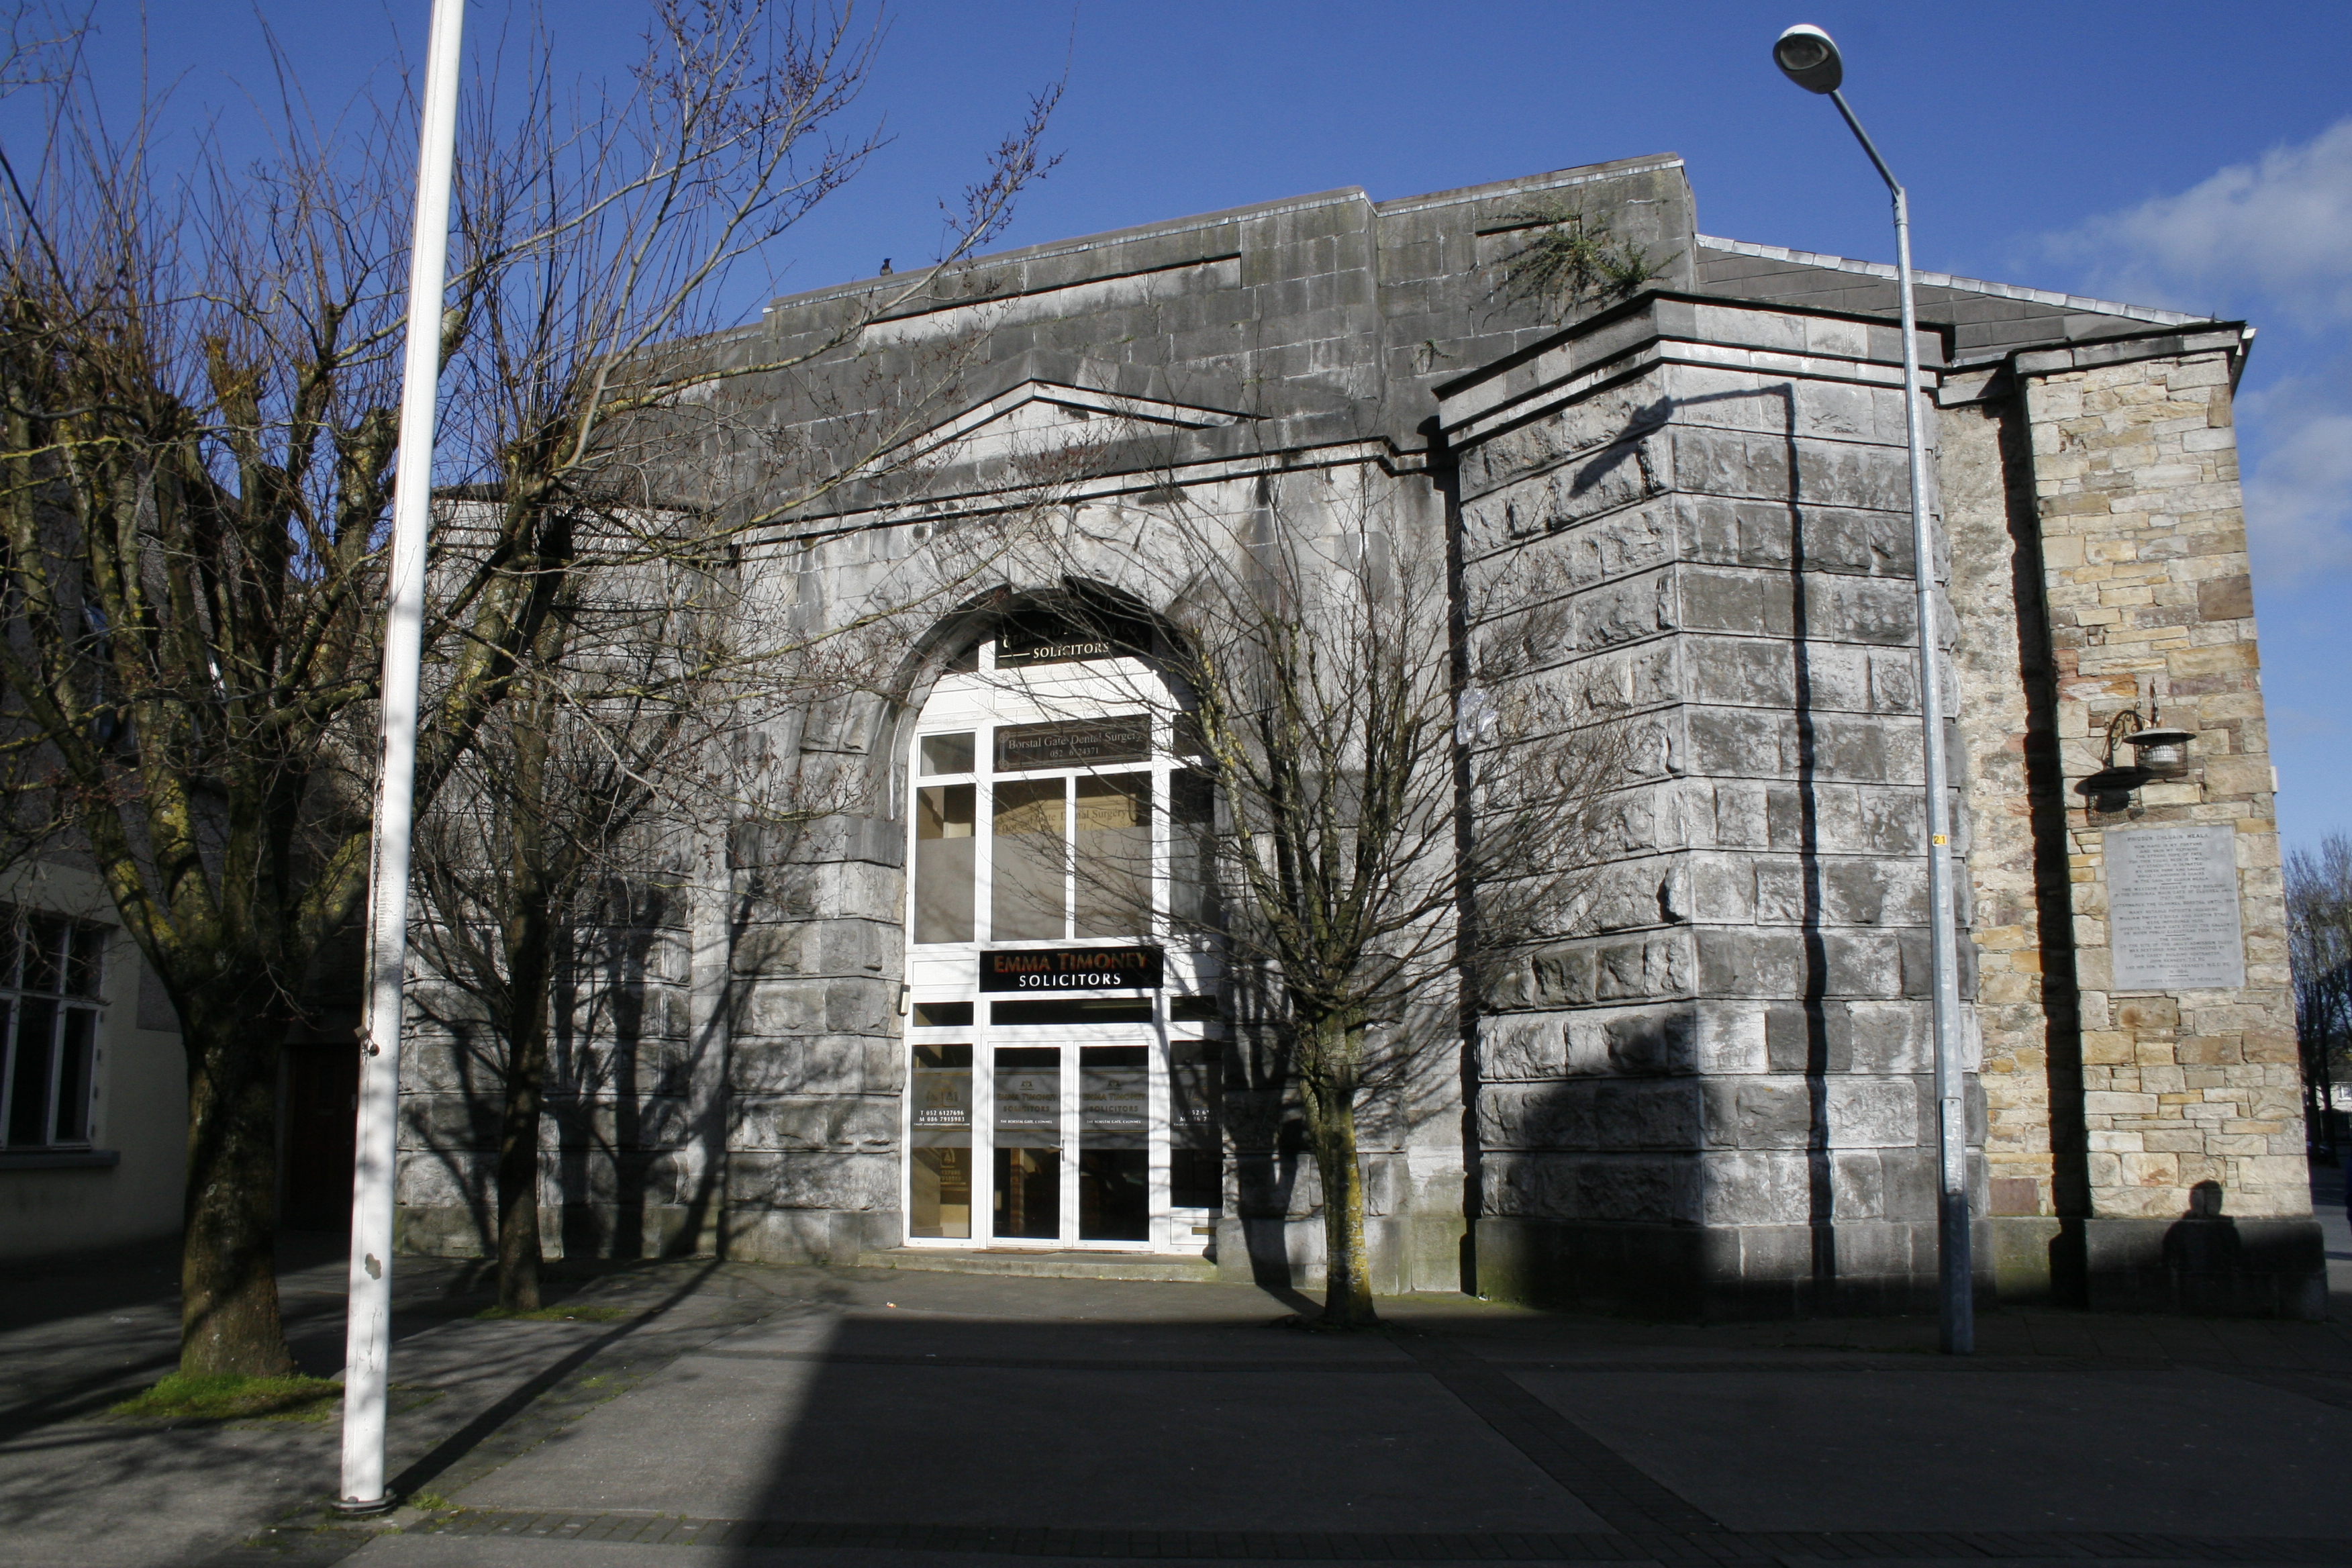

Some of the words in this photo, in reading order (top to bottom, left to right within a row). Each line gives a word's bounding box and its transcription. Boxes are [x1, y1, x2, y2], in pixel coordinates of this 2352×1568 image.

[1034, 642, 1109, 658] SOLICITORS
[1009, 737, 1040, 749] Borstal
[1044, 736, 1067, 747] Gate
[1071, 734, 1101, 744] Dental
[1105, 732, 1141, 743] Surgery
[1069, 747, 1099, 756] 624371
[1934, 836, 1945, 844] 21
[993, 954, 1052, 973] EMMA
[1057, 952, 1147, 971] TIMONEY
[1019, 973, 1121, 987] SOLICITORS
